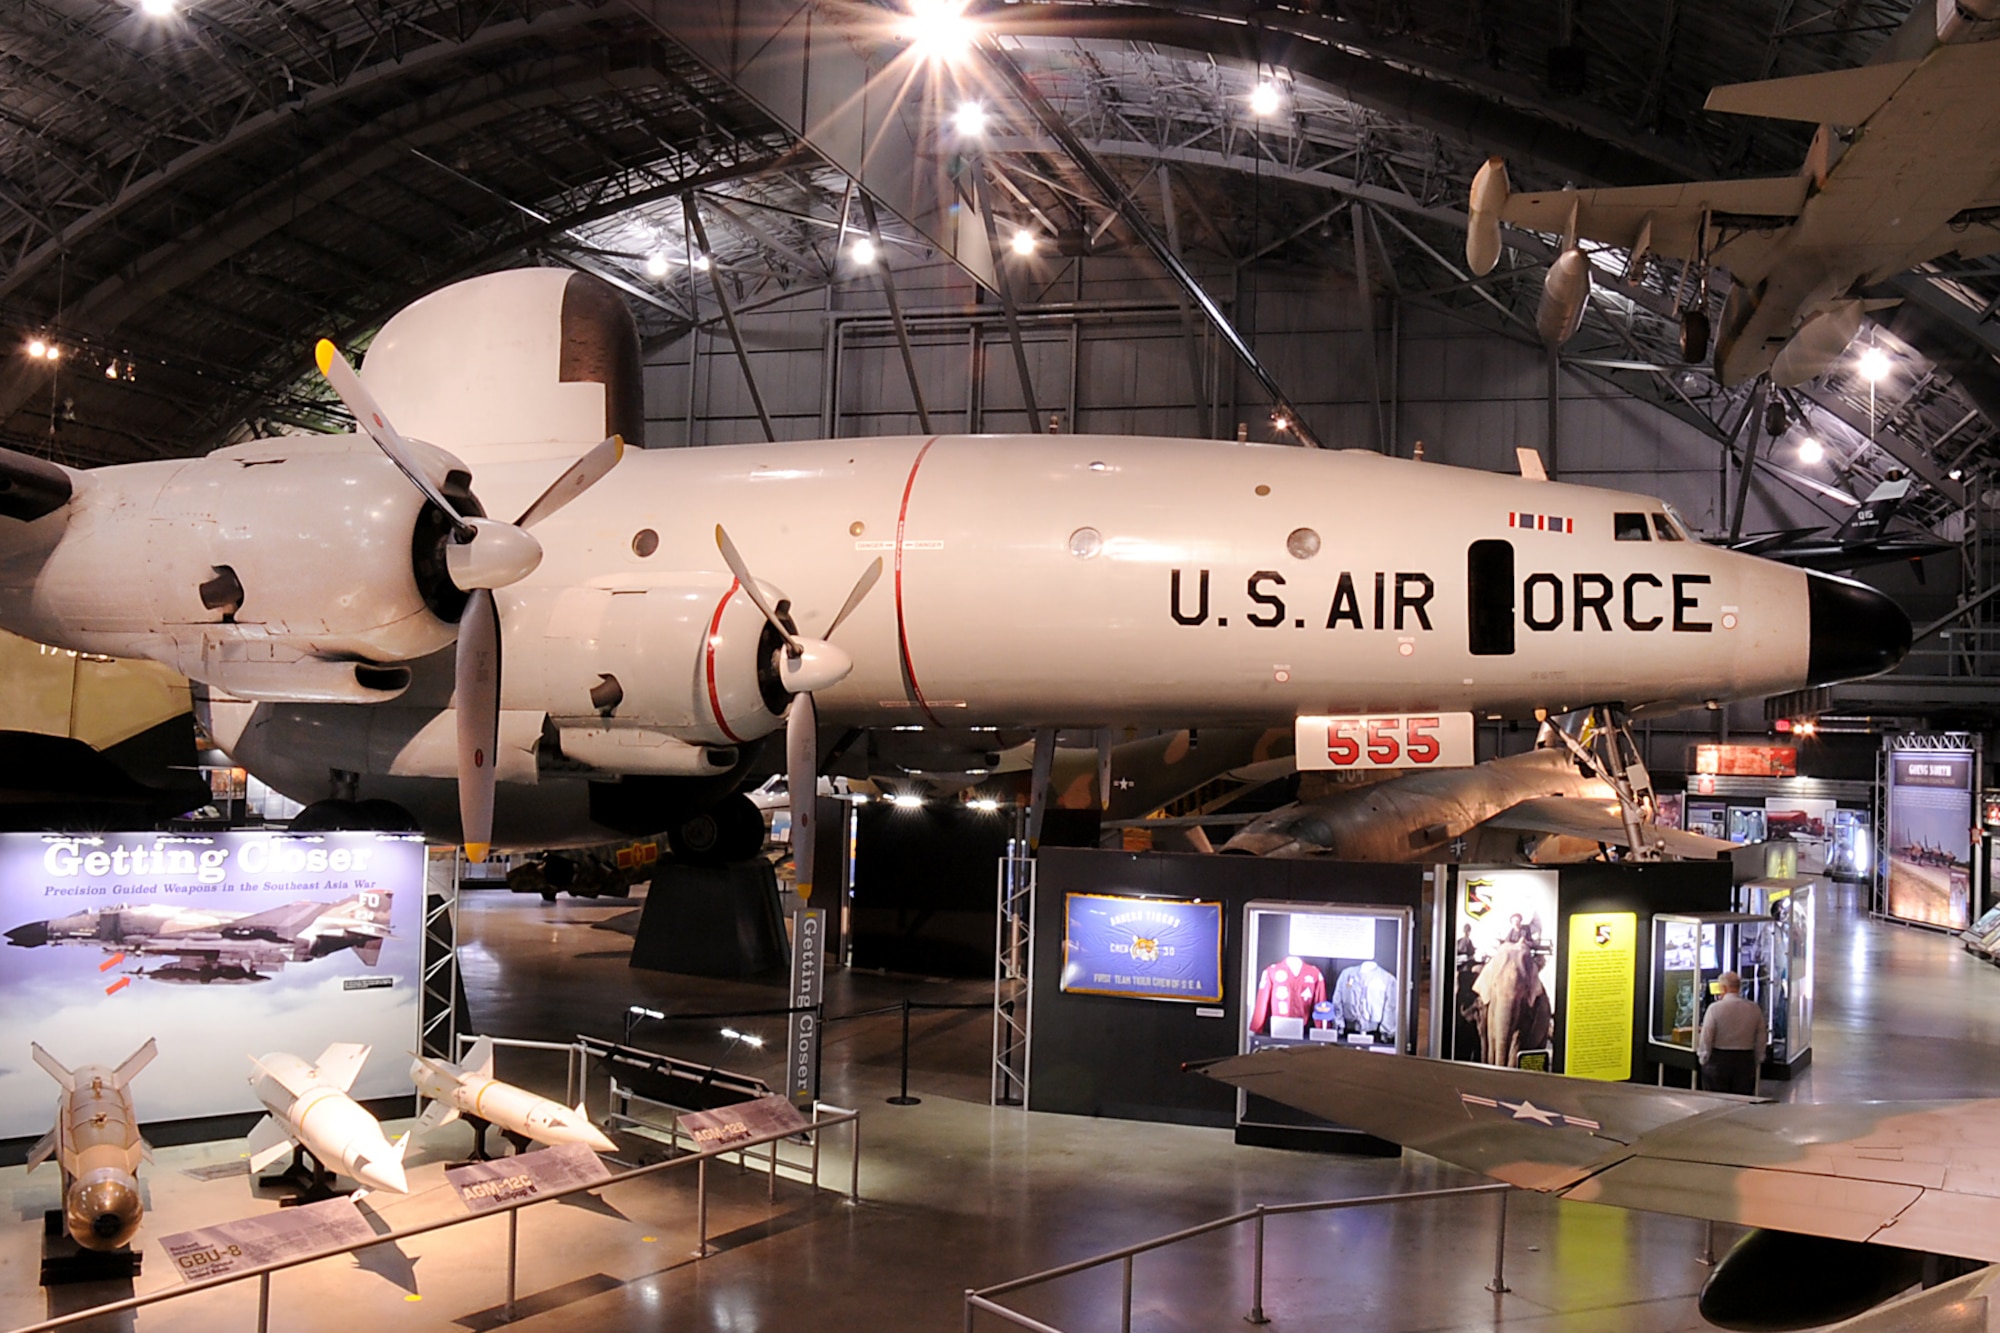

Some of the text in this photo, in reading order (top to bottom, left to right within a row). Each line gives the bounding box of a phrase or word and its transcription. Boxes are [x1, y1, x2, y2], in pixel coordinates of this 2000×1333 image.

[1171, 569, 1713, 632] U.S. AIR ORCE
[1328, 718, 1440, 765] 555
[44, 841, 372, 883] Getting Closer
[44, 879, 376, 897] Precision Guided Weapons in the Southeast Asia War
[1115, 975, 1131, 985] TEAM
[797, 919, 818, 1090] Getting Closer
[694, 1122, 748, 1142] AGM-12B
[462, 1174, 532, 1200] AGM-12C
[178, 1244, 242, 1268] GBU-8
